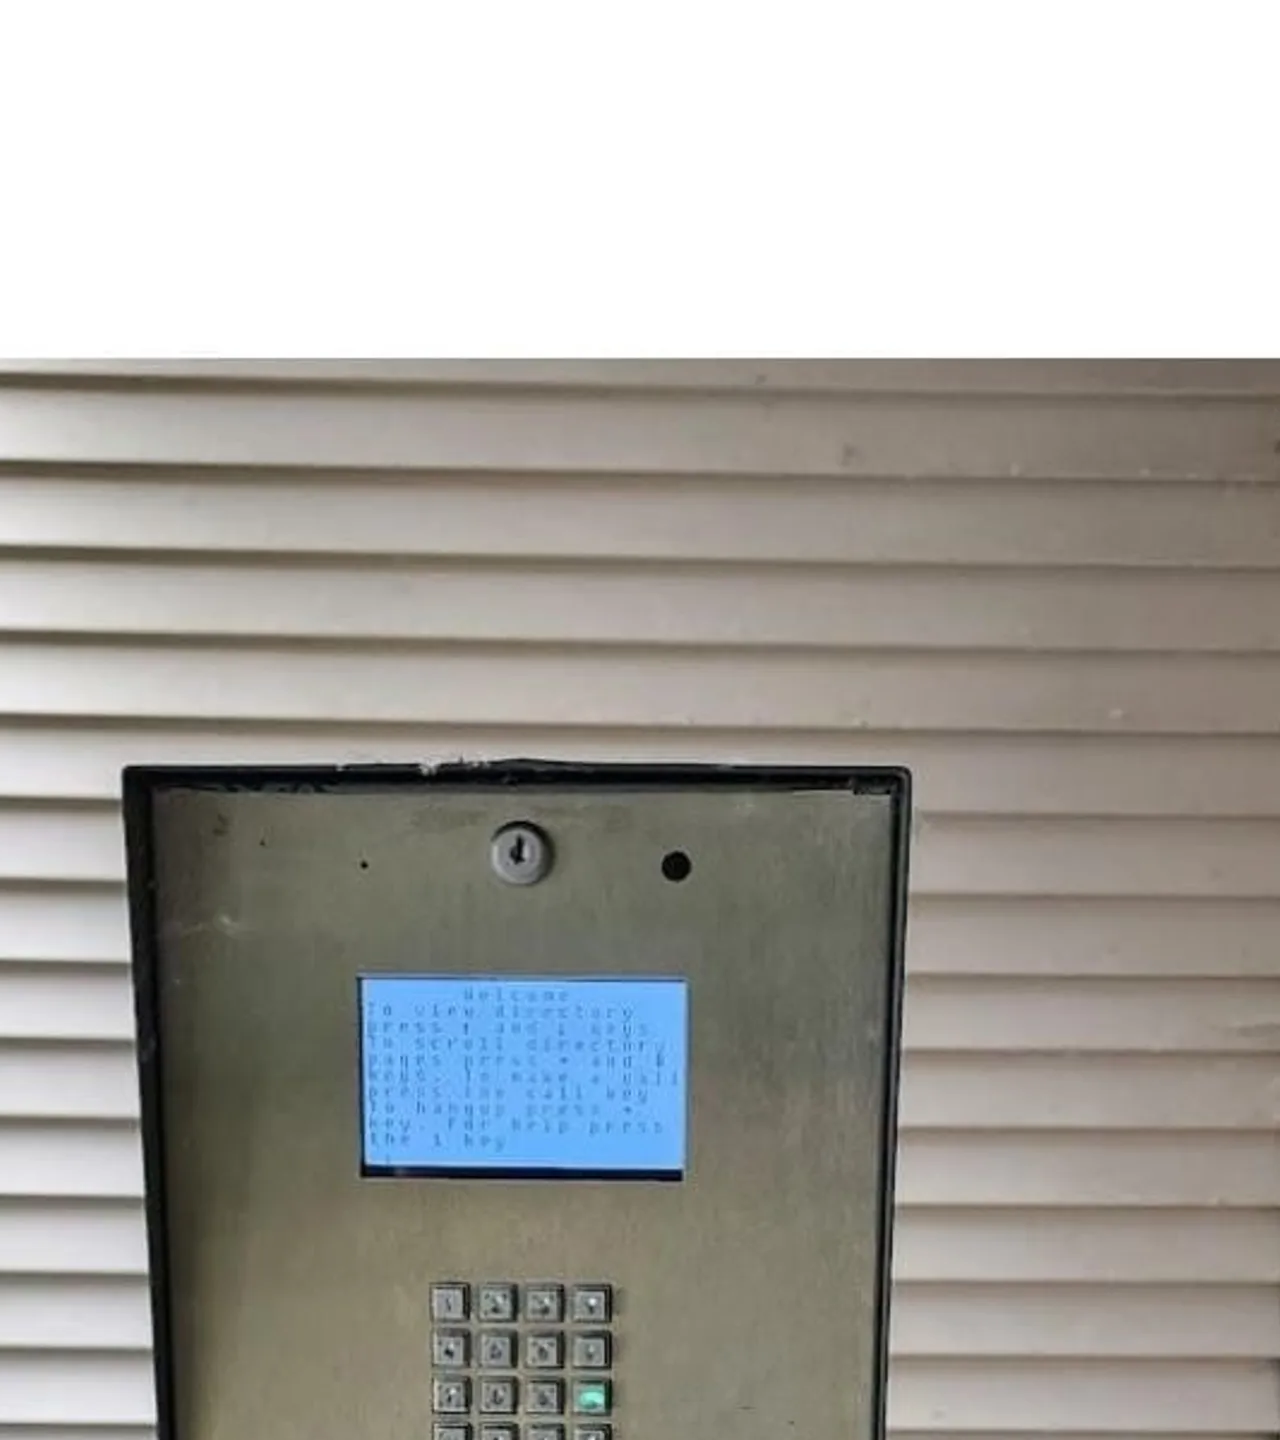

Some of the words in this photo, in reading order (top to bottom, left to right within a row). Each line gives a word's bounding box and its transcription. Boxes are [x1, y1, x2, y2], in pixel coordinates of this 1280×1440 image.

[463, 987, 571, 1001] Welcome
[495, 1004, 635, 1021] directory
[416, 1036, 507, 1049] scroll
[527, 1037, 666, 1054] directory
